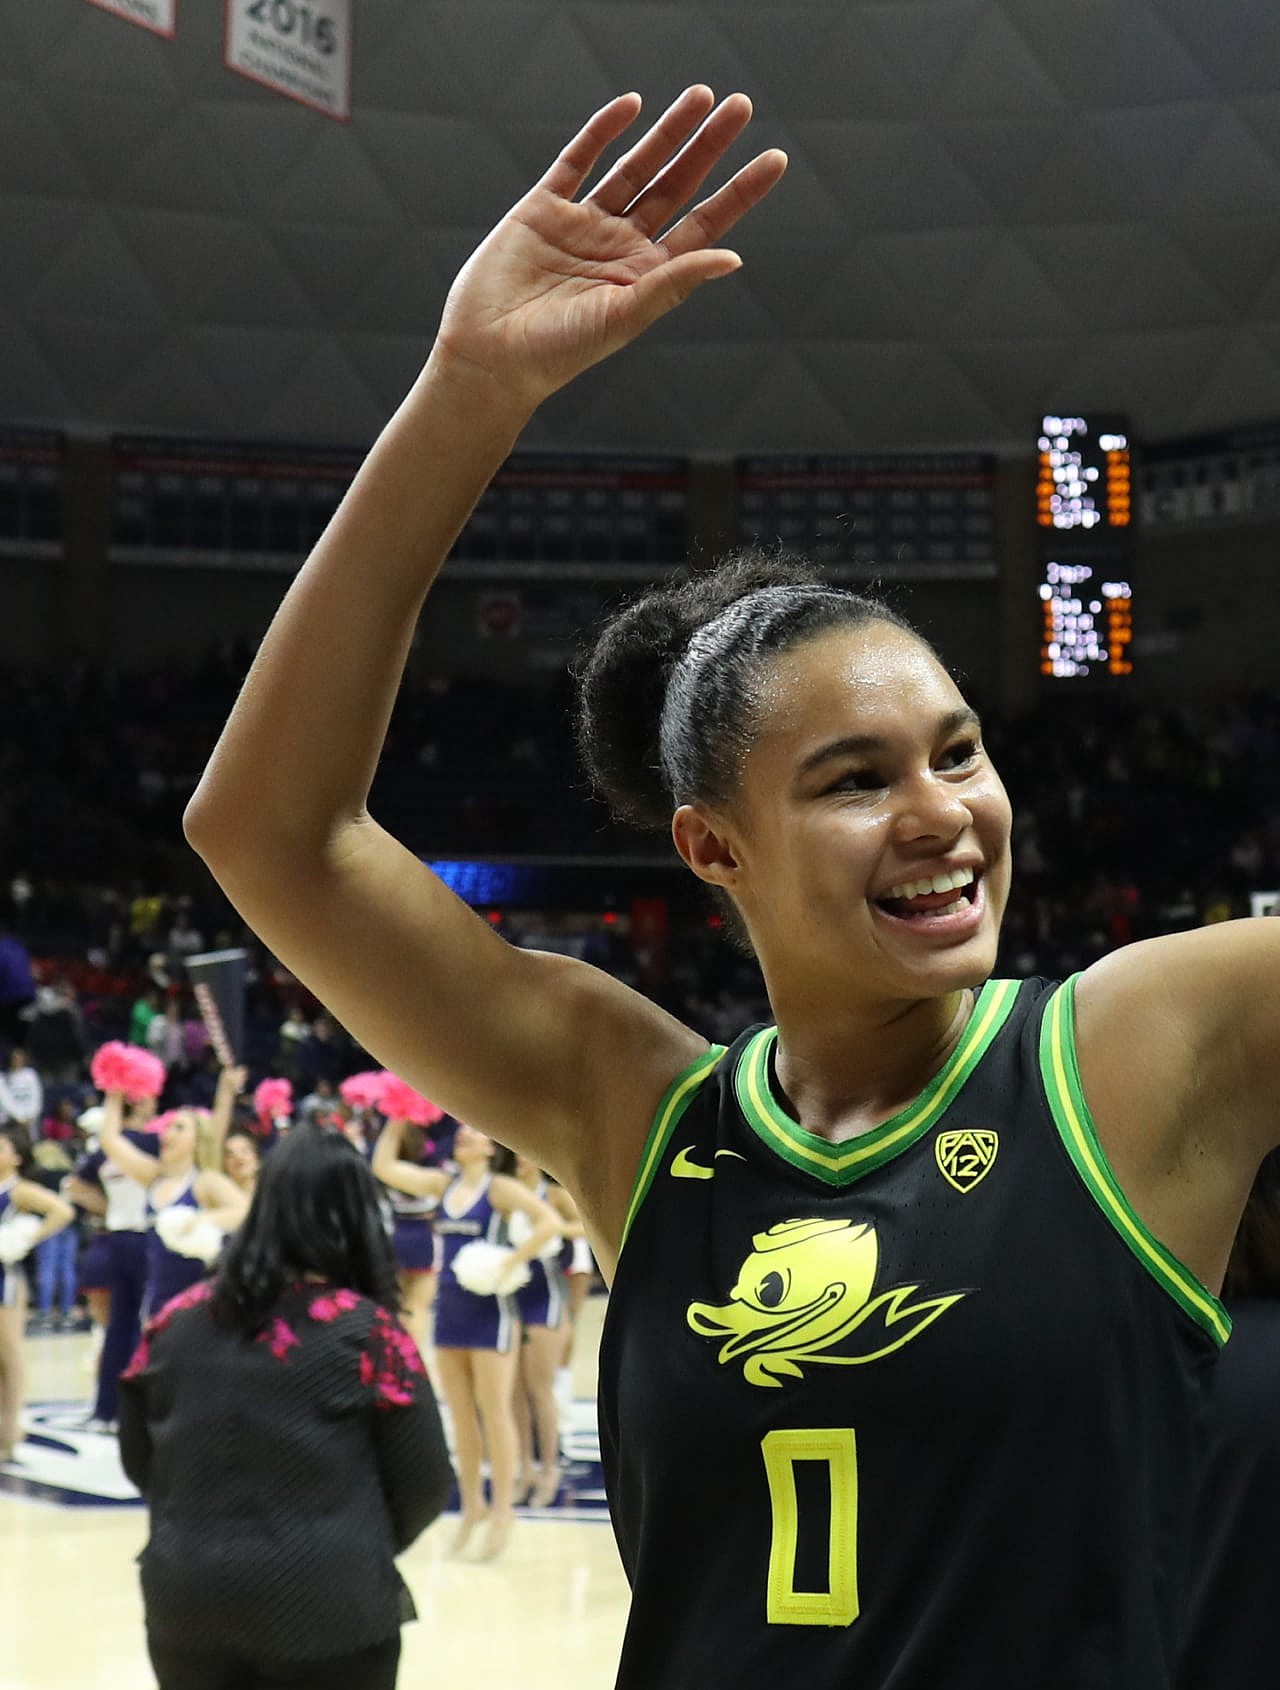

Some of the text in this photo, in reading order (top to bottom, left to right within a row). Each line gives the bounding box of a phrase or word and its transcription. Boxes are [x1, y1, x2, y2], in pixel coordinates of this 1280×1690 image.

[939, 1132, 995, 1167] PAC
[950, 1154, 980, 1177] 12
[761, 1427, 860, 1628] 0
